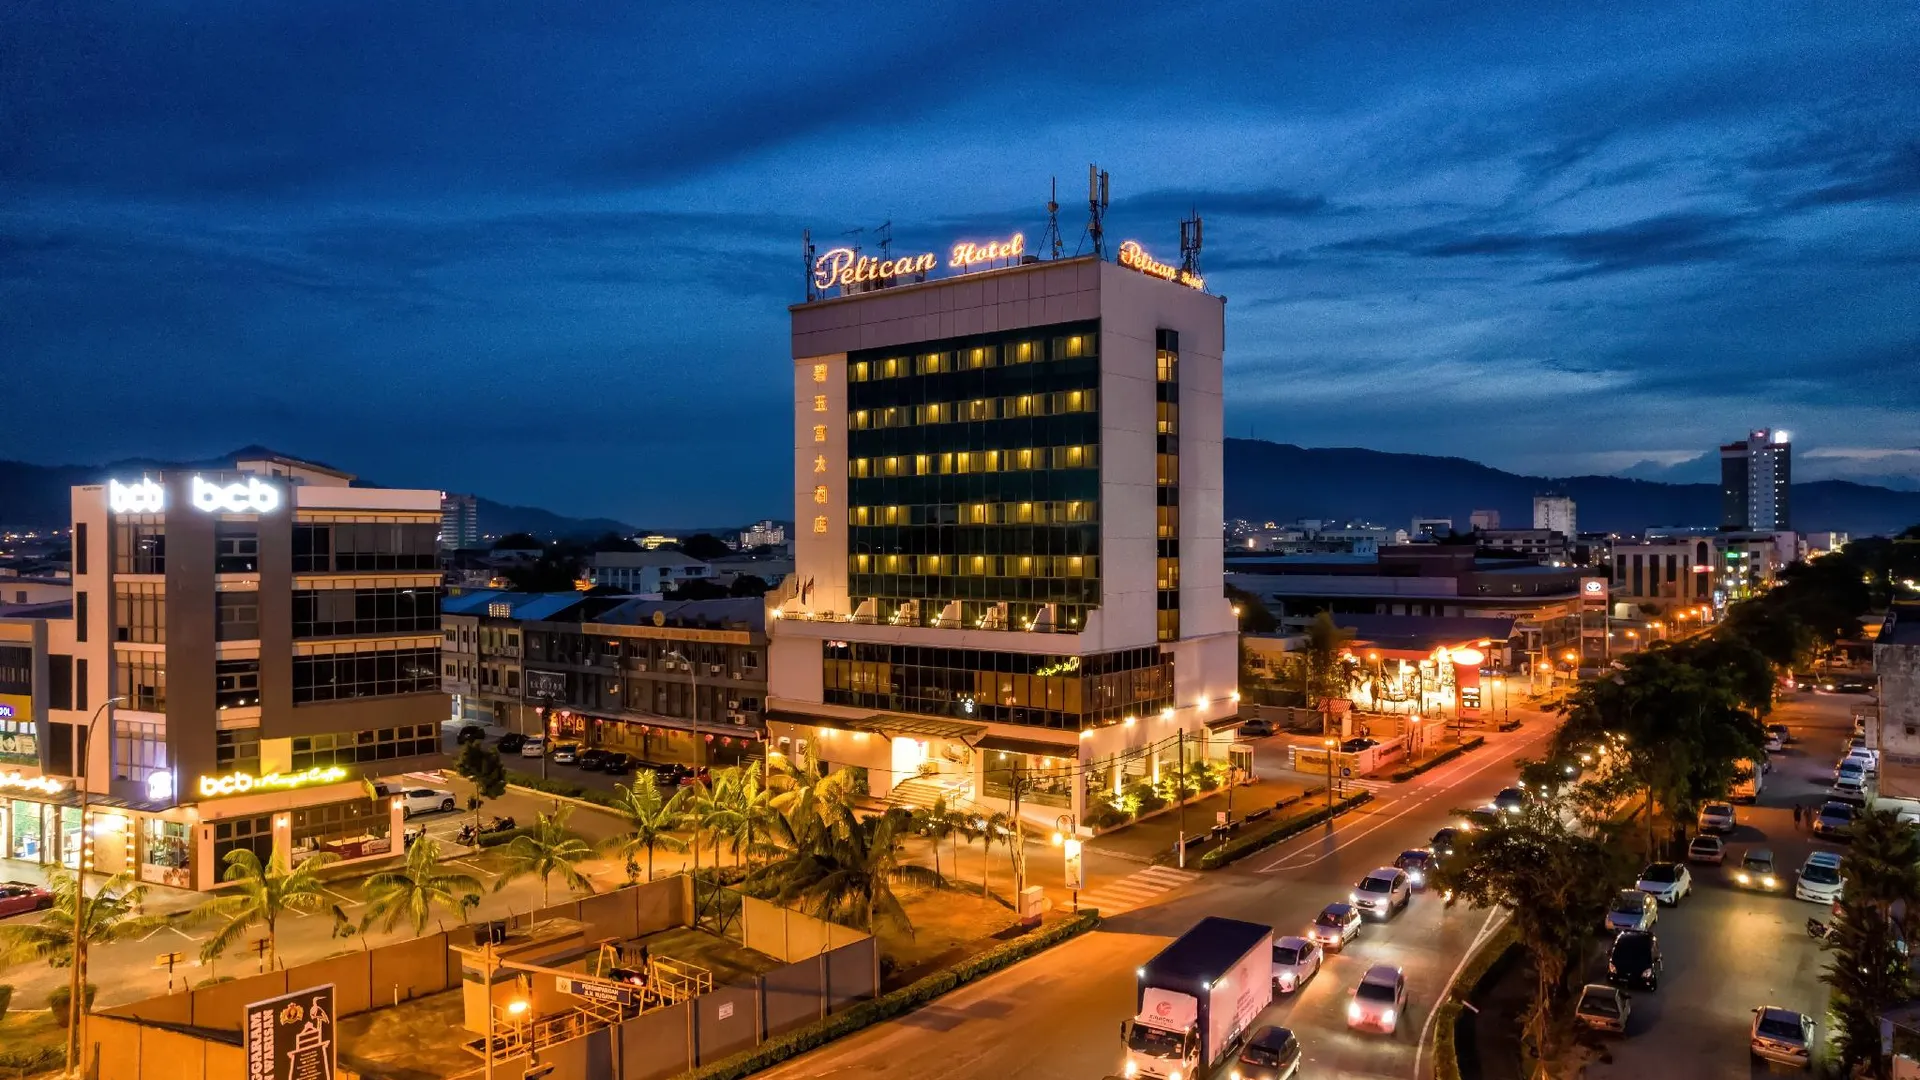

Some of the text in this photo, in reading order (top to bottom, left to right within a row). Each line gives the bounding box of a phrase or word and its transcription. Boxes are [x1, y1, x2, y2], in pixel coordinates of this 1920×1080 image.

[815, 232, 1024, 289] Pelican Hotel
[1120, 240, 1177, 280] Pelican
[110, 477, 164, 513] bcb
[193, 475, 279, 512] bcb
[200, 771, 252, 797] bcb
